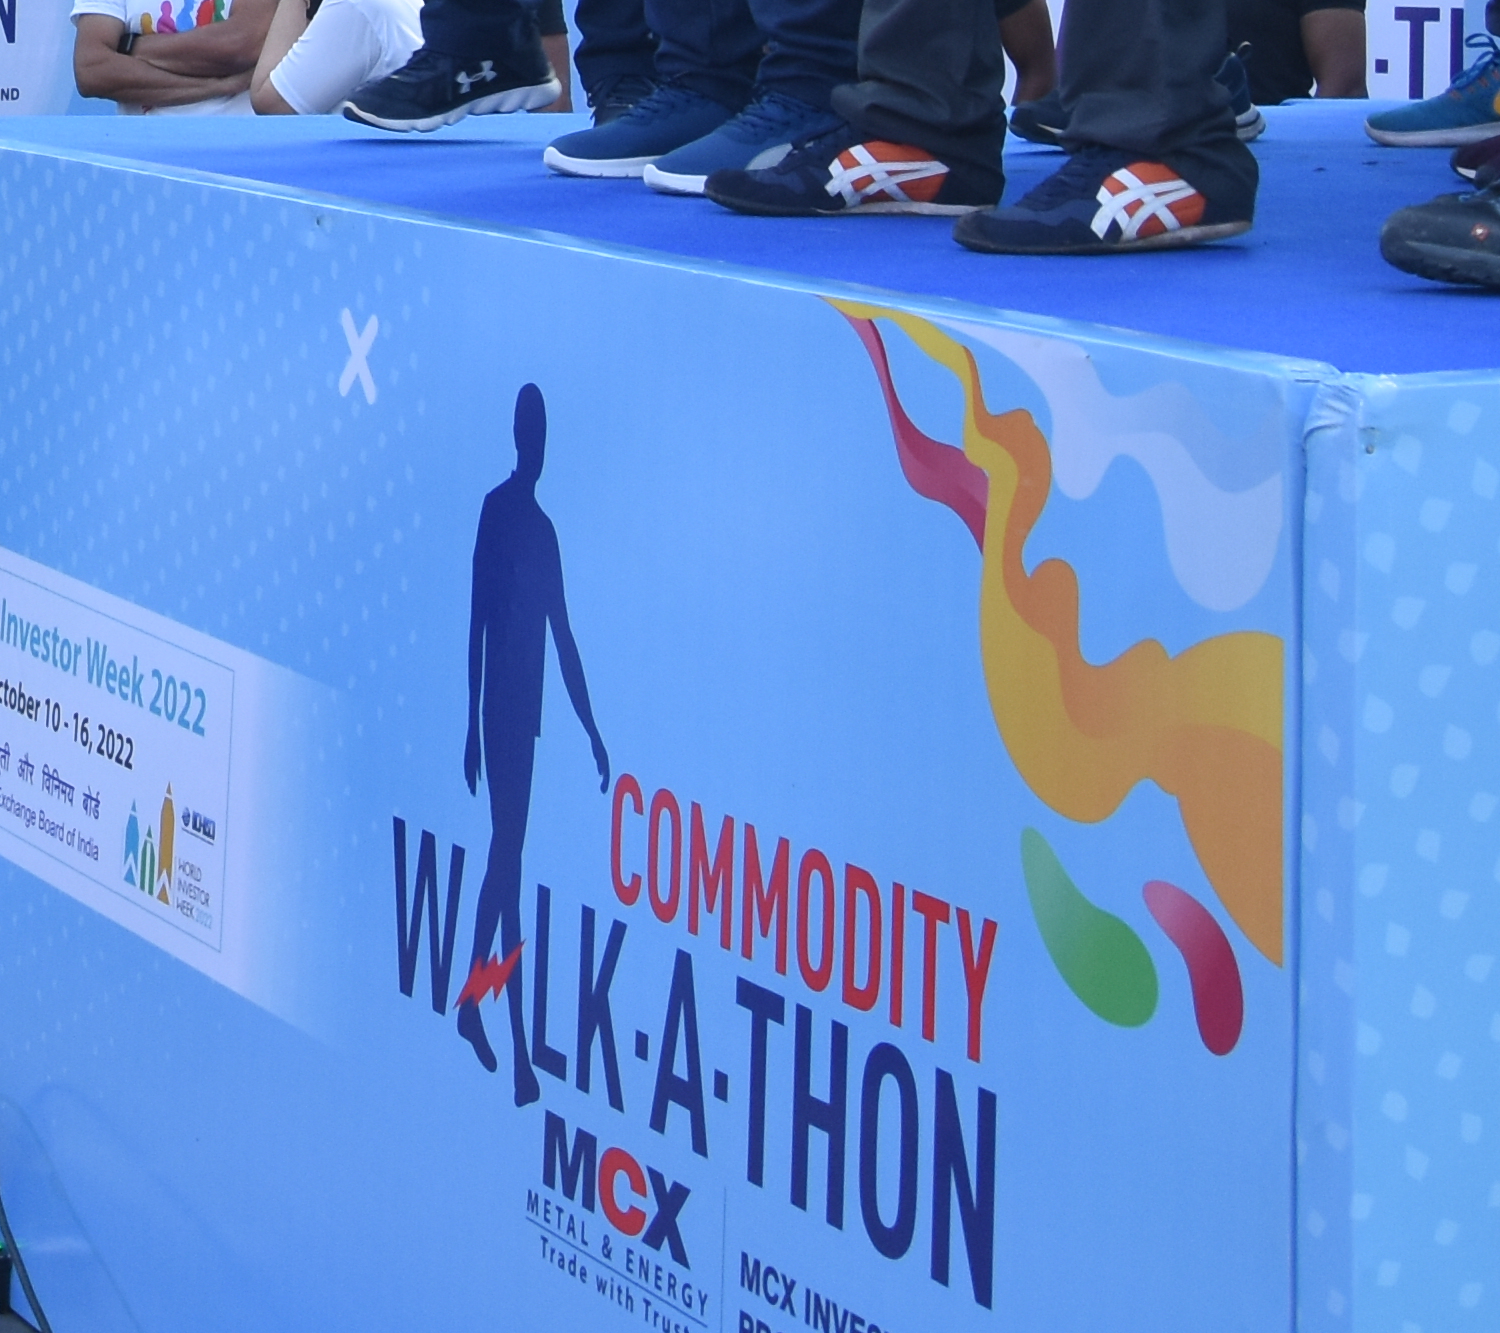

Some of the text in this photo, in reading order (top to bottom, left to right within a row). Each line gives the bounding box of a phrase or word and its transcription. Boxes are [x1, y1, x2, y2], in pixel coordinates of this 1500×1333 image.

[1, 597, 83, 677] Investor
[86, 636, 145, 709] Week
[149, 668, 208, 737] 2022
[44, 697, 62, 733] 10
[73, 712, 94, 755] 16,
[96, 722, 135, 771] 2022
[16, 752, 36, 786] और
[41, 763, 77, 808] विनिमय
[81, 785, 102, 822] बोर्ड
[38, 808, 65, 843] Board
[66, 823, 77, 847] of
[77, 829, 100, 863] India
[177, 856, 203, 884] WORLD
[175, 896, 197, 922] WEEK
[176, 877, 211, 909] INVESTOR
[608, 773, 998, 1064] COMMODITY
[541, 1109, 692, 1270] MCX
[525, 1188, 709, 1317] METAL & ENERGY
[540, 1235, 588, 1285] Trade
[596, 1270, 635, 1314] with
[642, 1296, 691, 1333] Trust
[739, 1251, 796, 1317] MCX
